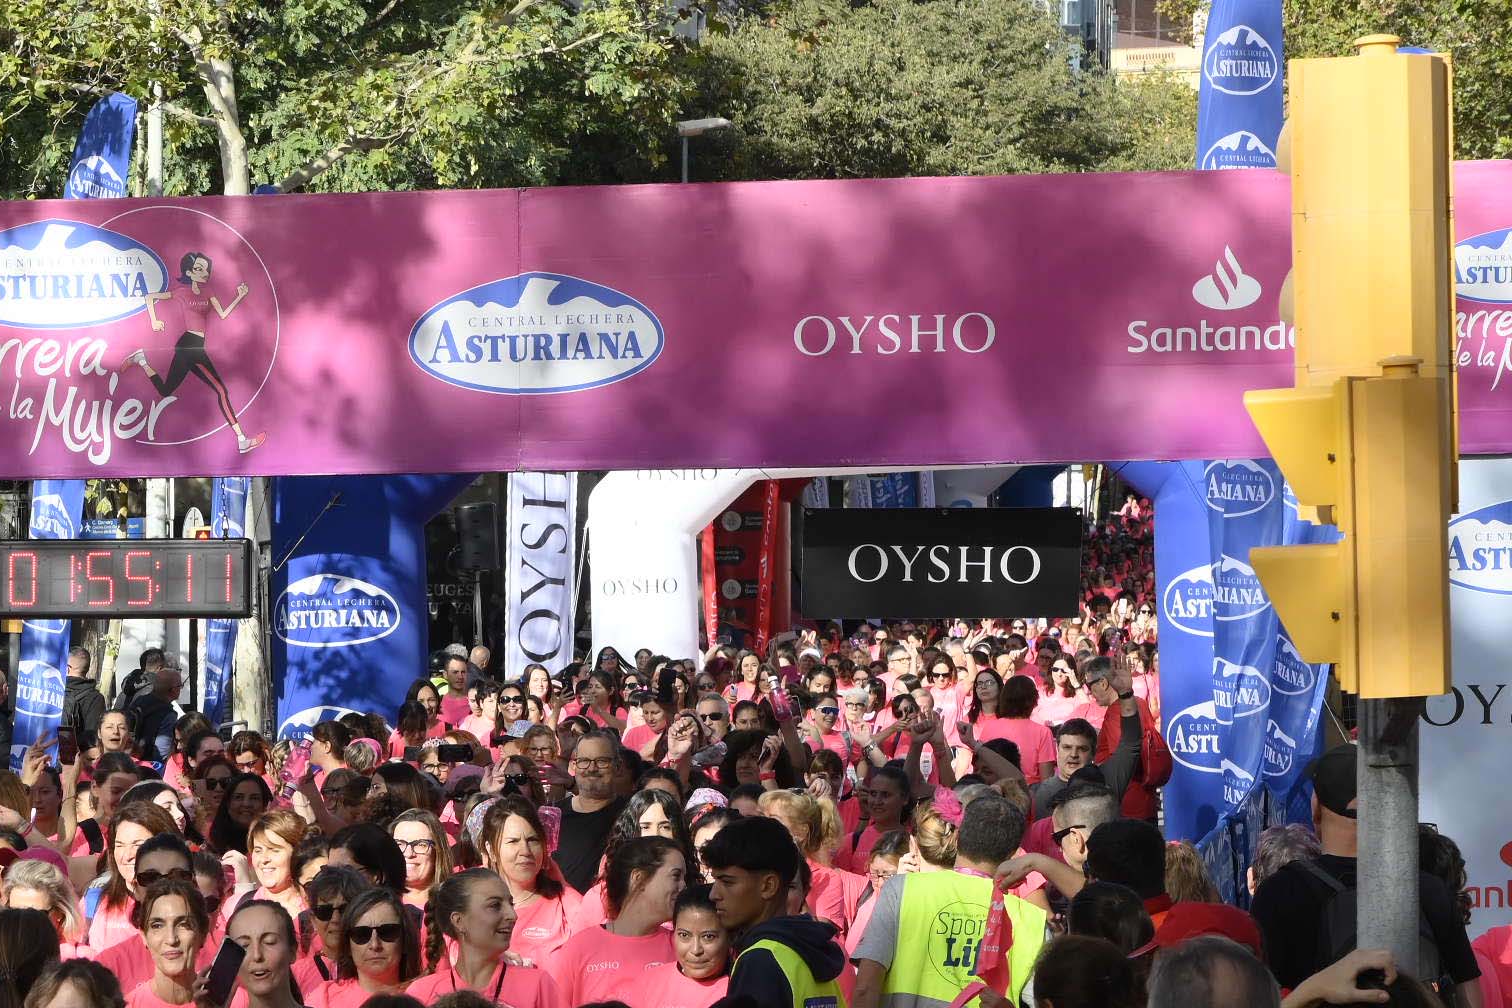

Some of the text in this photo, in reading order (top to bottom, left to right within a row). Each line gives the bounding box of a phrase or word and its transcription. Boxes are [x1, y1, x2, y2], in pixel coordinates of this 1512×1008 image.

[1210, 52, 1272, 78] ASTURIANA
[468, 312, 636, 328] CENTRAL LECHERA
[428, 319, 645, 364] ASTURIANA
[793, 312, 997, 356] OYSHO
[1477, 338, 1496, 367] la
[9, 382, 35, 420] la
[28, 371, 179, 466] Mujer
[847, 543, 1041, 584] OYSHO
[602, 577, 678, 597] OYSHO
[291, 598, 387, 608] CENTRAL LECHERA
[278, 604, 391, 630] ASTURIANA
[587, 961, 620, 973] OYSHO
